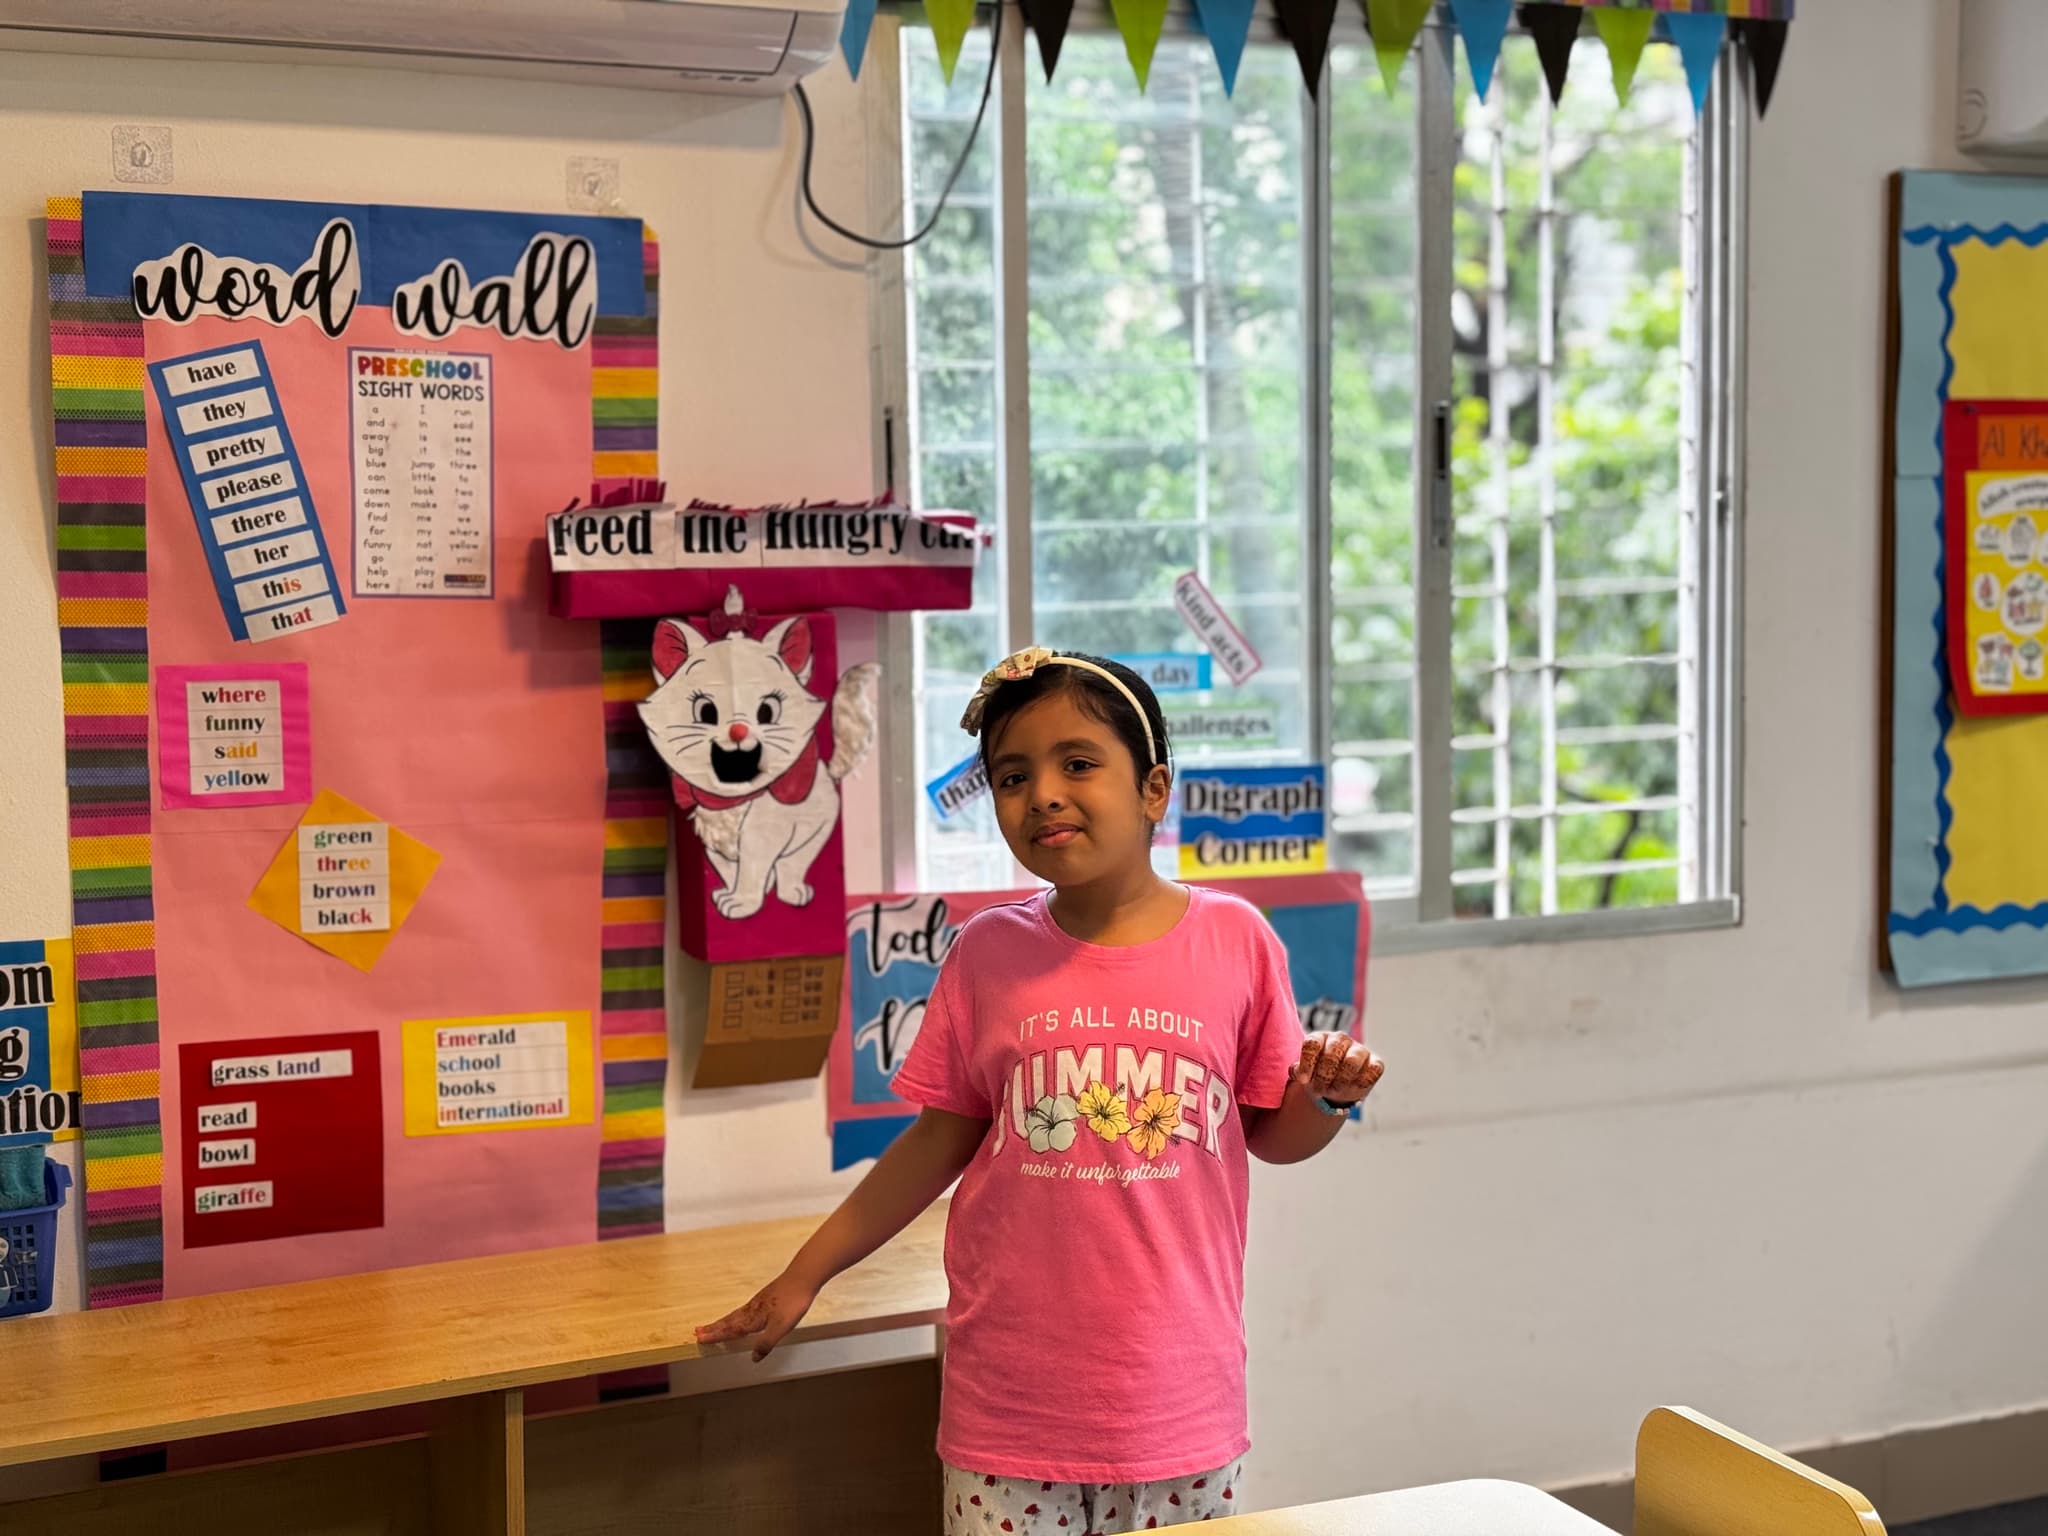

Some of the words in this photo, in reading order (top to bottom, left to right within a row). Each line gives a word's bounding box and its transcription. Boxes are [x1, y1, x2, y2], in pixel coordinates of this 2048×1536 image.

[134, 220, 358, 337] word
[396, 237, 593, 347] wall
[187, 361, 237, 383] have
[357, 355, 484, 380] PRESCHOOL
[358, 380, 413, 398] SIGHT
[420, 383, 484, 402] WORDS
[203, 400, 246, 422] they
[366, 418, 385, 427] and
[453, 420, 473, 429] said
[362, 433, 389, 443] away
[206, 437, 266, 466] pretty
[368, 444, 384, 456] big
[455, 447, 471, 456] the
[366, 459, 386, 468] blue
[411, 460, 435, 470] jump
[450, 460, 477, 469] three
[411, 472, 436, 481] little
[216, 471, 283, 503] please
[414, 485, 434, 494] look
[364, 498, 390, 508] down
[411, 499, 437, 508] make
[231, 509, 286, 534] there
[368, 512, 388, 522] find
[369, 525, 385, 536] for
[417, 529, 432, 537] my
[449, 527, 479, 537] where
[553, 509, 653, 556] Feed
[683, 512, 747, 554] the
[765, 510, 908, 556] Hungry
[363, 538, 392, 551] funny
[416, 540, 432, 549] not
[449, 539, 479, 551] yellow
[254, 544, 289, 564] her
[371, 555, 384, 564] go
[367, 565, 388, 577] help
[414, 567, 435, 577] play
[263, 577, 302, 598] this
[366, 579, 390, 589] here
[416, 580, 434, 589] red
[271, 606, 313, 630] that
[1177, 581, 1217, 630] Kind
[1211, 632, 1244, 674] acts
[1152, 662, 1191, 685] day
[202, 687, 266, 703] where
[205, 715, 265, 734] funny
[1163, 714, 1271, 737] hallenges
[214, 742, 257, 759] said
[205, 770, 270, 791] yellow
[1184, 780, 1323, 817] Digraph
[314, 831, 372, 848] green
[1196, 836, 1317, 867] Corner
[317, 856, 371, 871] three
[313, 884, 375, 899] brown
[318, 908, 372, 926] black
[1020, 1010, 1060, 1042] IT'S
[1070, 1006, 1115, 1028] ALL
[1127, 1008, 1203, 1042] ABOUT
[437, 1028, 516, 1048] Emerald
[214, 1064, 270, 1083] grass
[277, 1057, 321, 1076] land
[438, 1054, 501, 1072] school
[439, 1079, 496, 1097] books
[201, 1107, 248, 1127] read
[440, 1098, 563, 1122] international
[201, 1144, 249, 1163] bowl
[1021, 1161, 1057, 1179] make
[1061, 1162, 1074, 1179] it
[1076, 1160, 1181, 1188] unforgettable
[197, 1187, 266, 1211] giraffe
